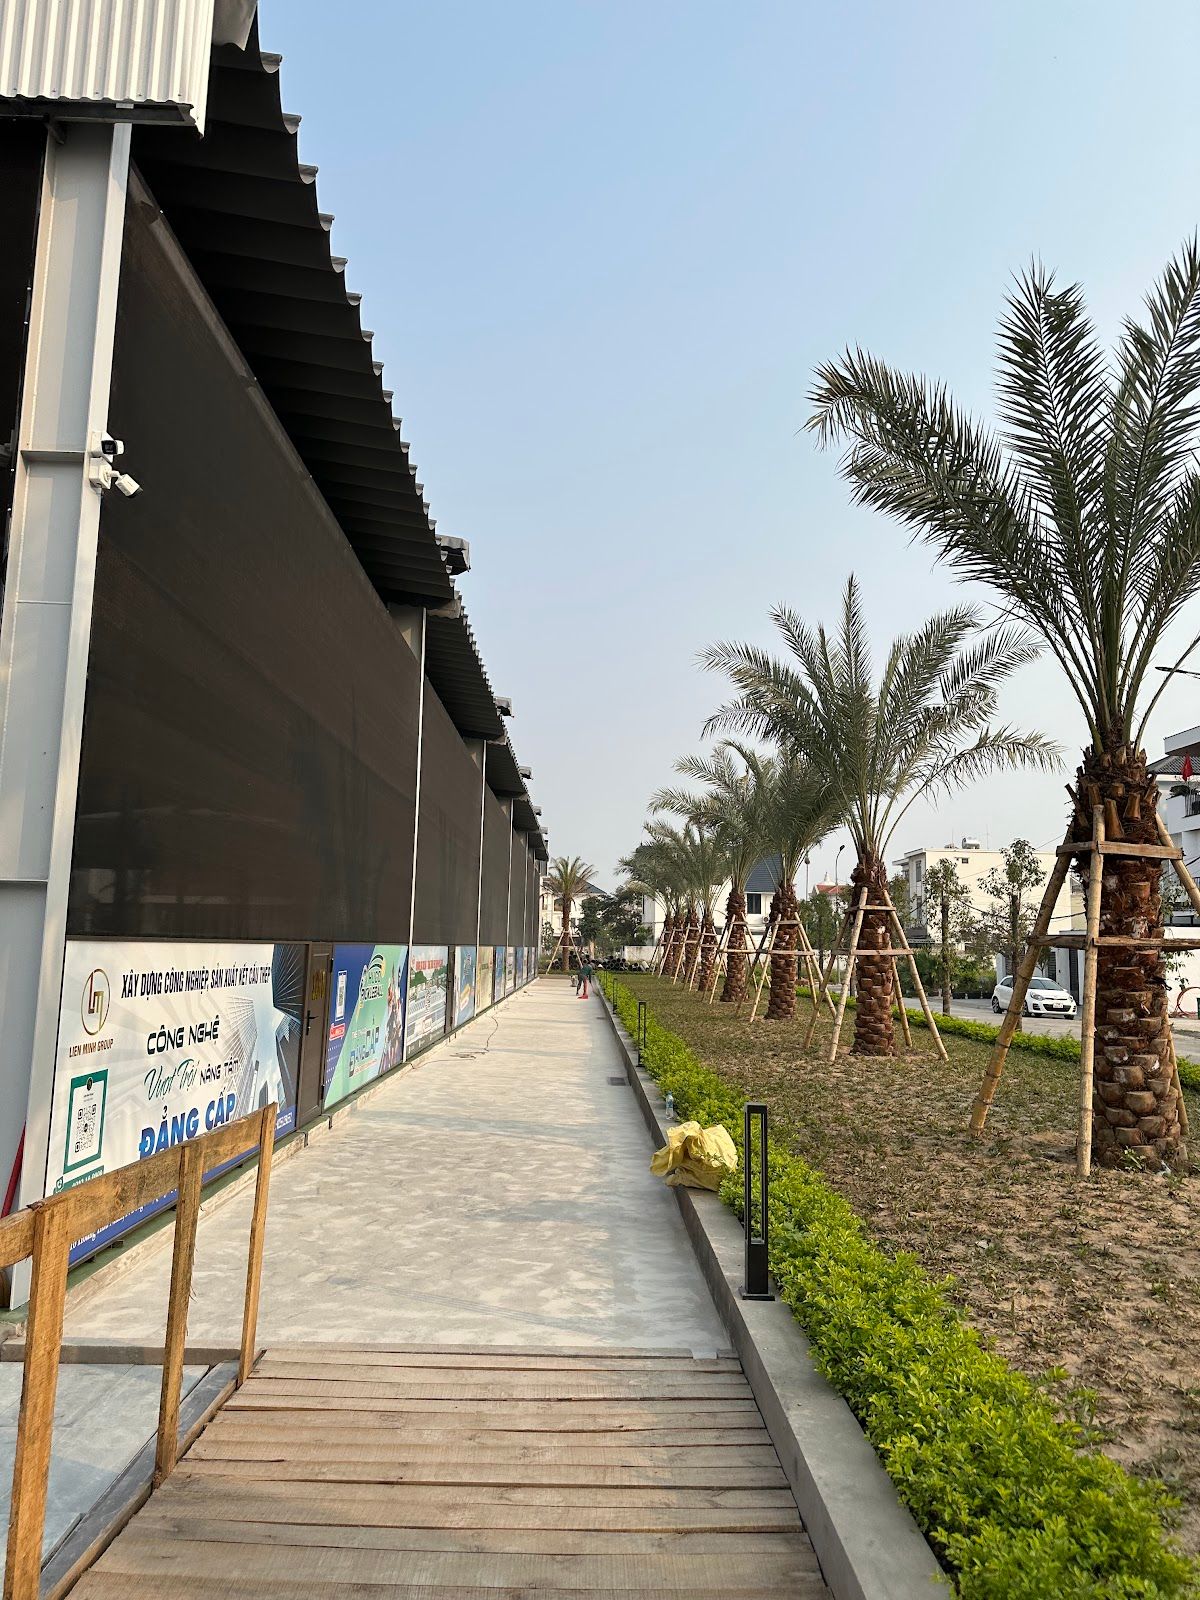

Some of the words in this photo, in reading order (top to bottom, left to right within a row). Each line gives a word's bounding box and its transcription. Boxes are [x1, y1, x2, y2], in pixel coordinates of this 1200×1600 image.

[121, 969, 139, 998] XÂY
[140, 971, 162, 1000] DỰNG
[164, 967, 184, 993] CÔNG
[185, 966, 209, 994] NGHIỆP,
[211, 962, 224, 988] SẢN
[224, 961, 238, 987] XUẤT
[239, 962, 249, 986] KẾT
[69, 1045, 81, 1058] LIEN
[82, 1042, 97, 1055] MINH
[97, 1038, 114, 1051] GROUP
[147, 1025, 184, 1055] CÔNG
[189, 1015, 220, 1045] NGHỆ
[200, 1064, 222, 1085] NÂNG
[138, 1105, 199, 1160] ĐẲNG
[205, 1087, 236, 1131] CẤP
